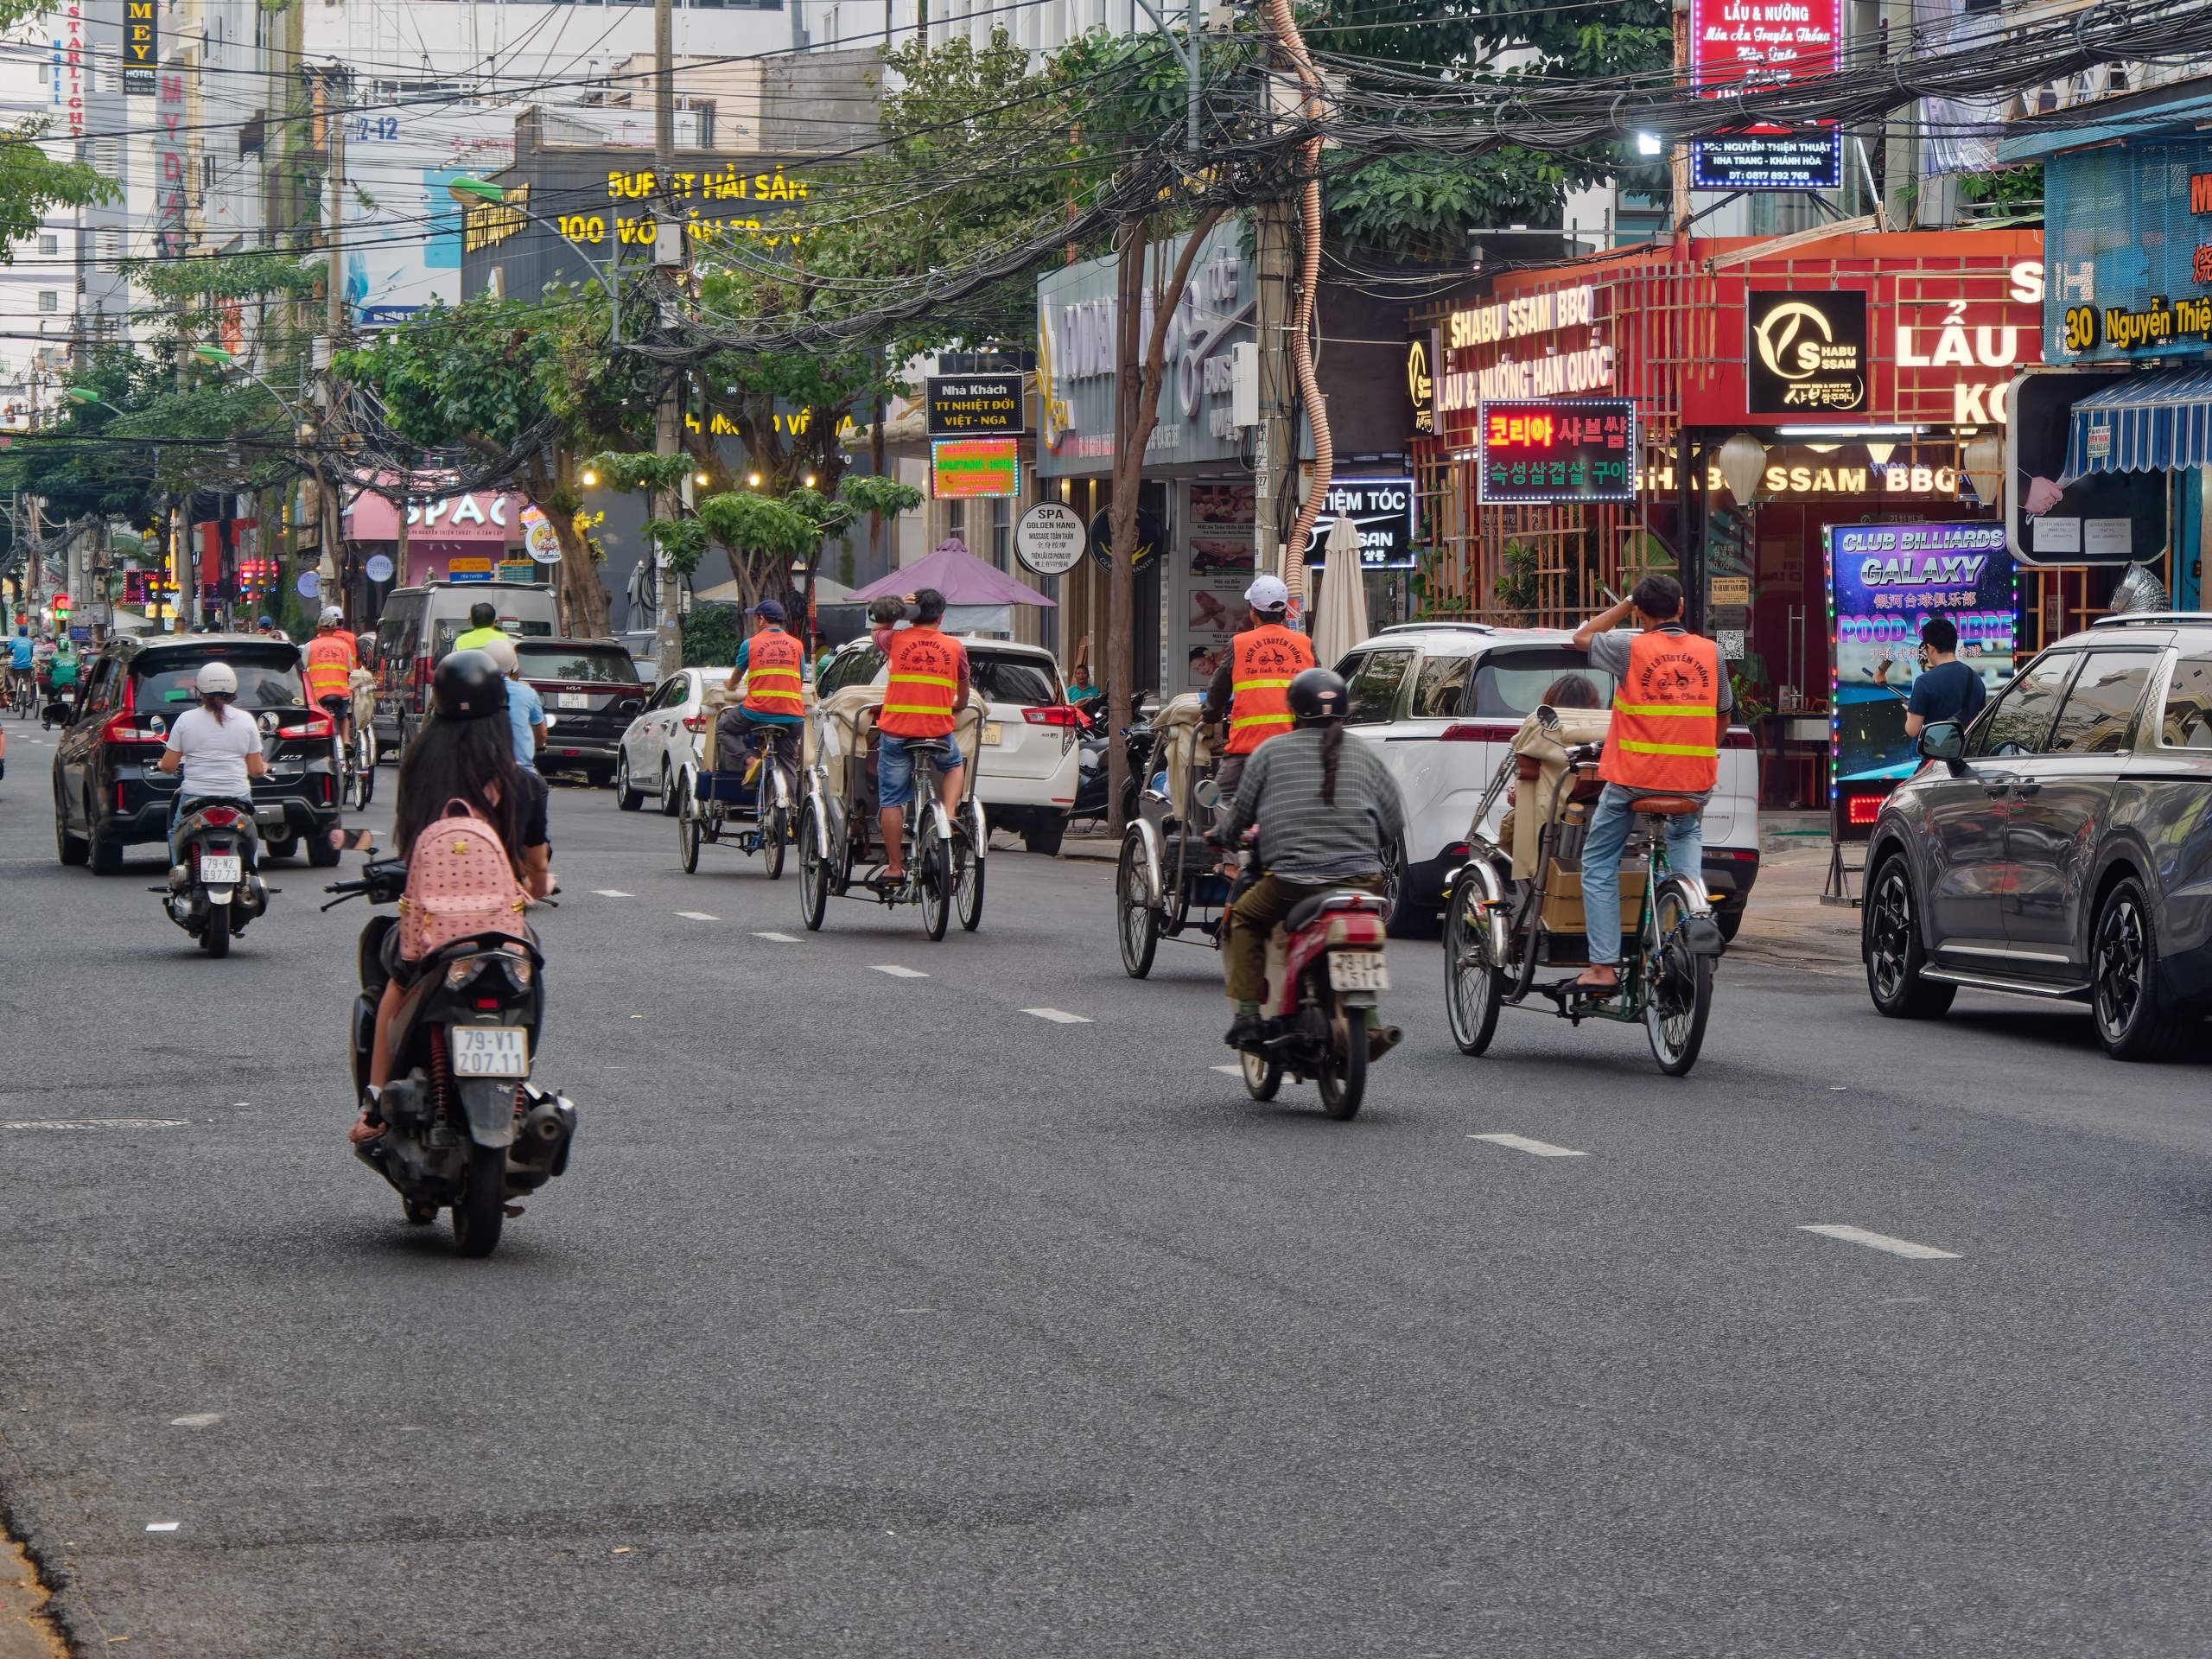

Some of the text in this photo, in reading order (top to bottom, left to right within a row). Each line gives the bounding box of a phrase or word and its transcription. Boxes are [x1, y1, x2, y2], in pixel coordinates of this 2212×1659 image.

[1752, 7, 1762, 21] &
[67, 6, 84, 137] STARLIGHT
[126, 69, 156, 79] HOTEL
[1724, 140, 1765, 152] NGUYỄN
[1800, 143, 1832, 155] THUẬT
[1713, 156, 1732, 165] NHA
[1733, 156, 1764, 165] TRANG
[1770, 156, 1801, 165] KHÁNH
[1746, 171, 1768, 180] 0817
[1771, 171, 1789, 180] 892
[1791, 171, 1809, 180] 768
[557, 215, 604, 245] 100
[1451, 284, 1594, 349] SHABU SSAM BBQ
[2066, 304, 2095, 349] 30
[2107, 297, 2171, 349] Nguyễn
[1897, 300, 2018, 367] LẨU
[1465, 372, 1478, 408] &
[1534, 346, 1568, 397] HÀN
[1567, 327, 1613, 392] QUỐC
[1821, 359, 1857, 370] SSAM
[969, 385, 1007, 395] Khách
[935, 402, 950, 411] TT
[952, 398, 989, 412] NHIỆT
[944, 414, 972, 429] VIỆT
[981, 416, 1007, 426] NGA
[1488, 415, 1553, 448] 코리아
[1558, 415, 1627, 449] 샤브쌈
[1490, 461, 1626, 486] 숙성삼겹살 구이
[1766, 467, 1866, 492] SSAM
[1885, 467, 1955, 493] BBQ
[1367, 487, 1406, 511] TÓC
[1038, 509, 1064, 519] SPA
[1842, 530, 2005, 552] CLUB BILLIARDS
[1860, 556, 1985, 586] GALAXY
[1873, 591, 1977, 609] 银河台球俱乐部
[1837, 613, 1908, 644] POOD
[459, 1052, 522, 1073] 207.11
